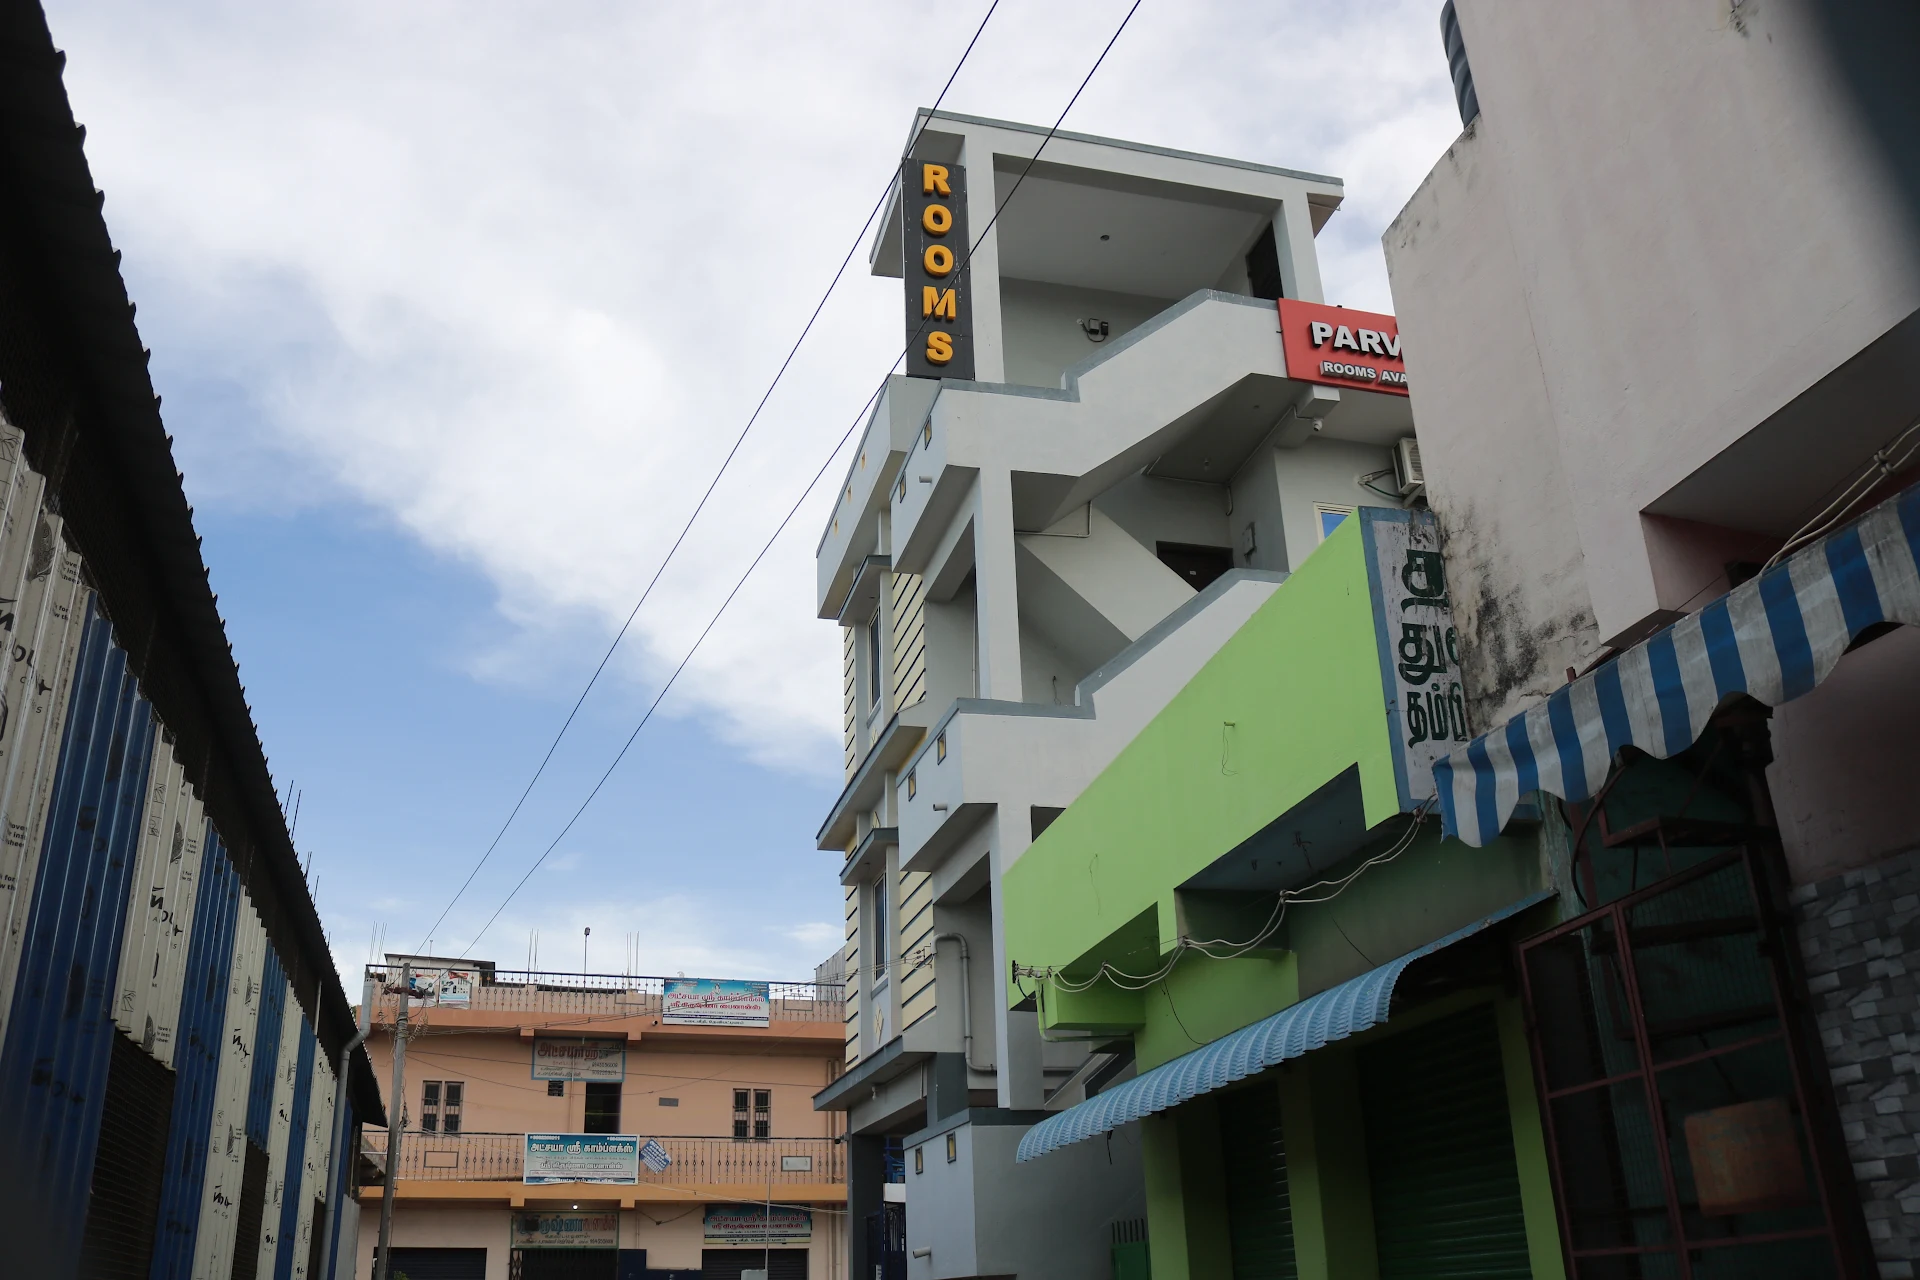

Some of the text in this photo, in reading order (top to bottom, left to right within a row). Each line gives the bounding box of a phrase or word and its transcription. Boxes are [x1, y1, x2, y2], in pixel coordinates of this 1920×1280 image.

[922, 162, 956, 366] ROOMS
[1320, 360, 1377, 384] ROOMS
[530, 1142, 564, 1153] அட்சயா
